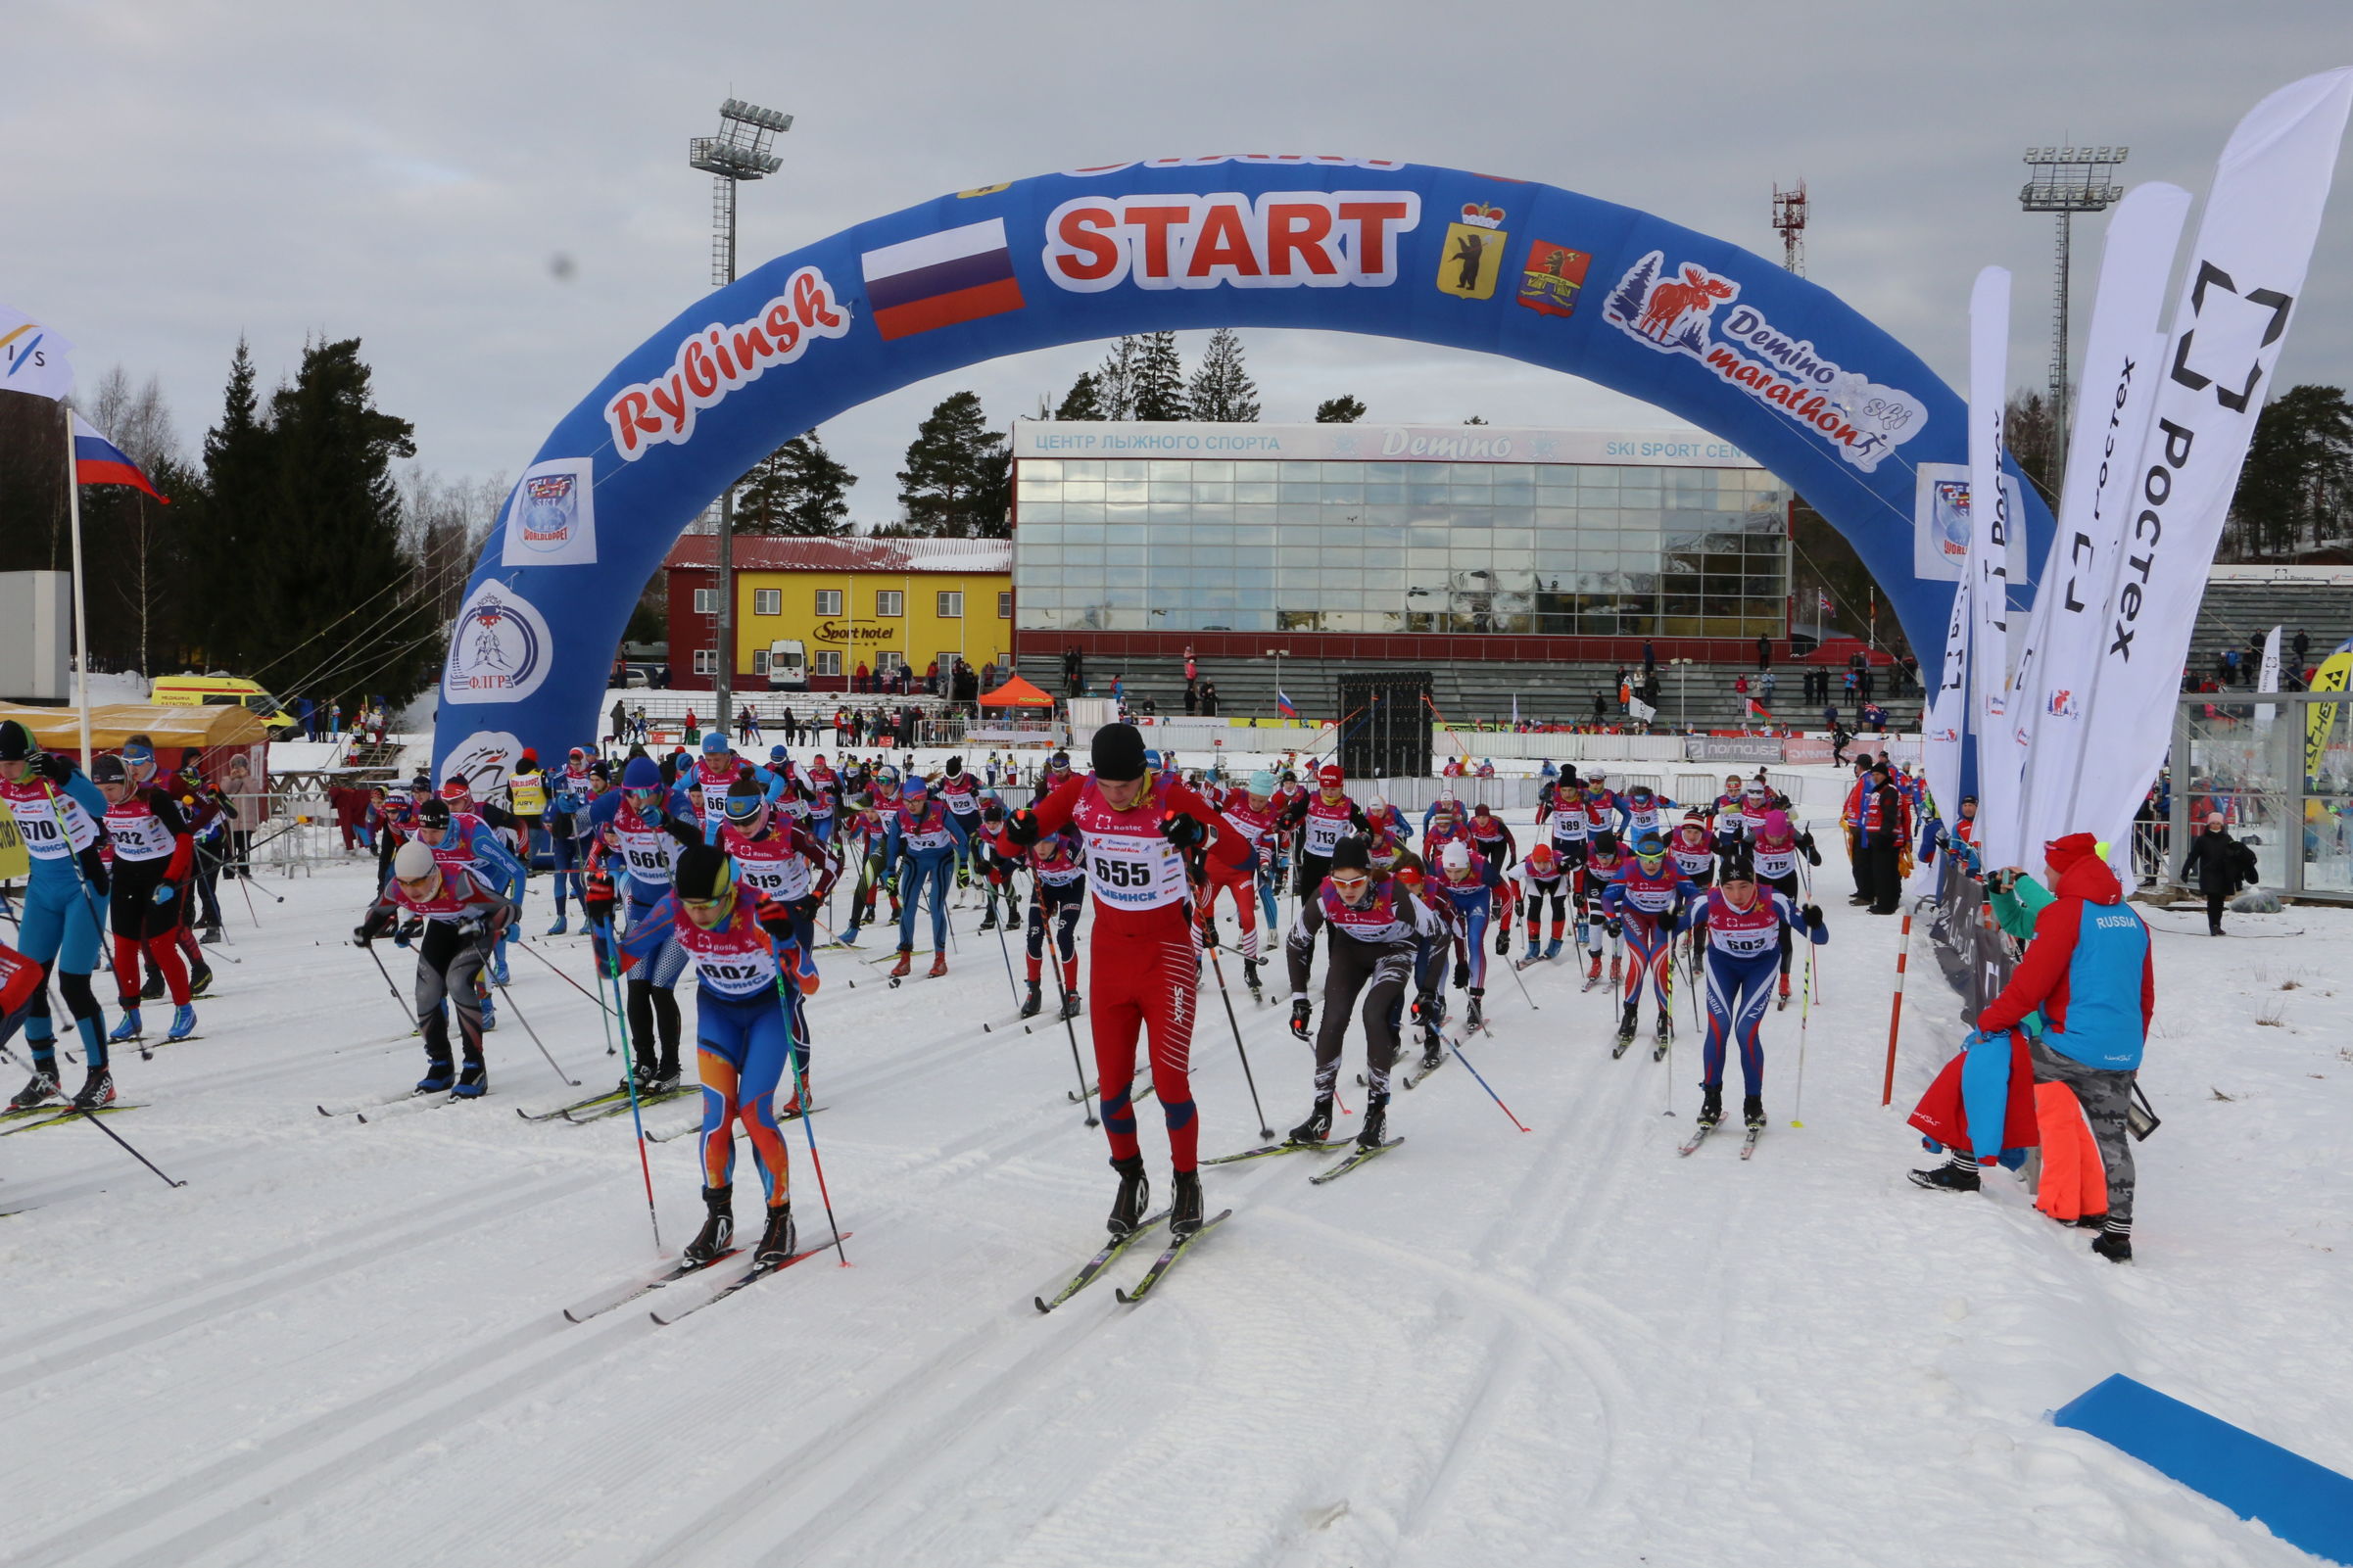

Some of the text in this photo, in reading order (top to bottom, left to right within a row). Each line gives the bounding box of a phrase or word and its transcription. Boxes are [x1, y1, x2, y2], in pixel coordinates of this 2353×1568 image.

[1056, 202, 1407, 280] START
[1729, 309, 1835, 385] Demino
[612, 273, 840, 451] Rybinsk
[1707, 348, 1861, 447] marathon
[1862, 398, 1912, 431] ski
[1035, 435, 1280, 451] ЦЕНТР ЛЫЖНОГО СПОРТА
[1382, 429, 1513, 459] Demino
[1606, 441, 1746, 458] SKI SPORT CEN
[2109, 417, 2194, 663] Ростех
[821, 621, 893, 641] Sport hotel
[468, 675, 505, 689] ФЛГР
[707, 796, 727, 811] 66
[1315, 831, 1336, 845] 713
[629, 849, 671, 869] 666
[1094, 857, 1150, 887] 655
[1096, 882, 1157, 902] РЫБИНСК
[2095, 916, 2137, 929] RUSSIA
[700, 964, 761, 980] 602
[1174, 985, 1186, 1024] Swix
